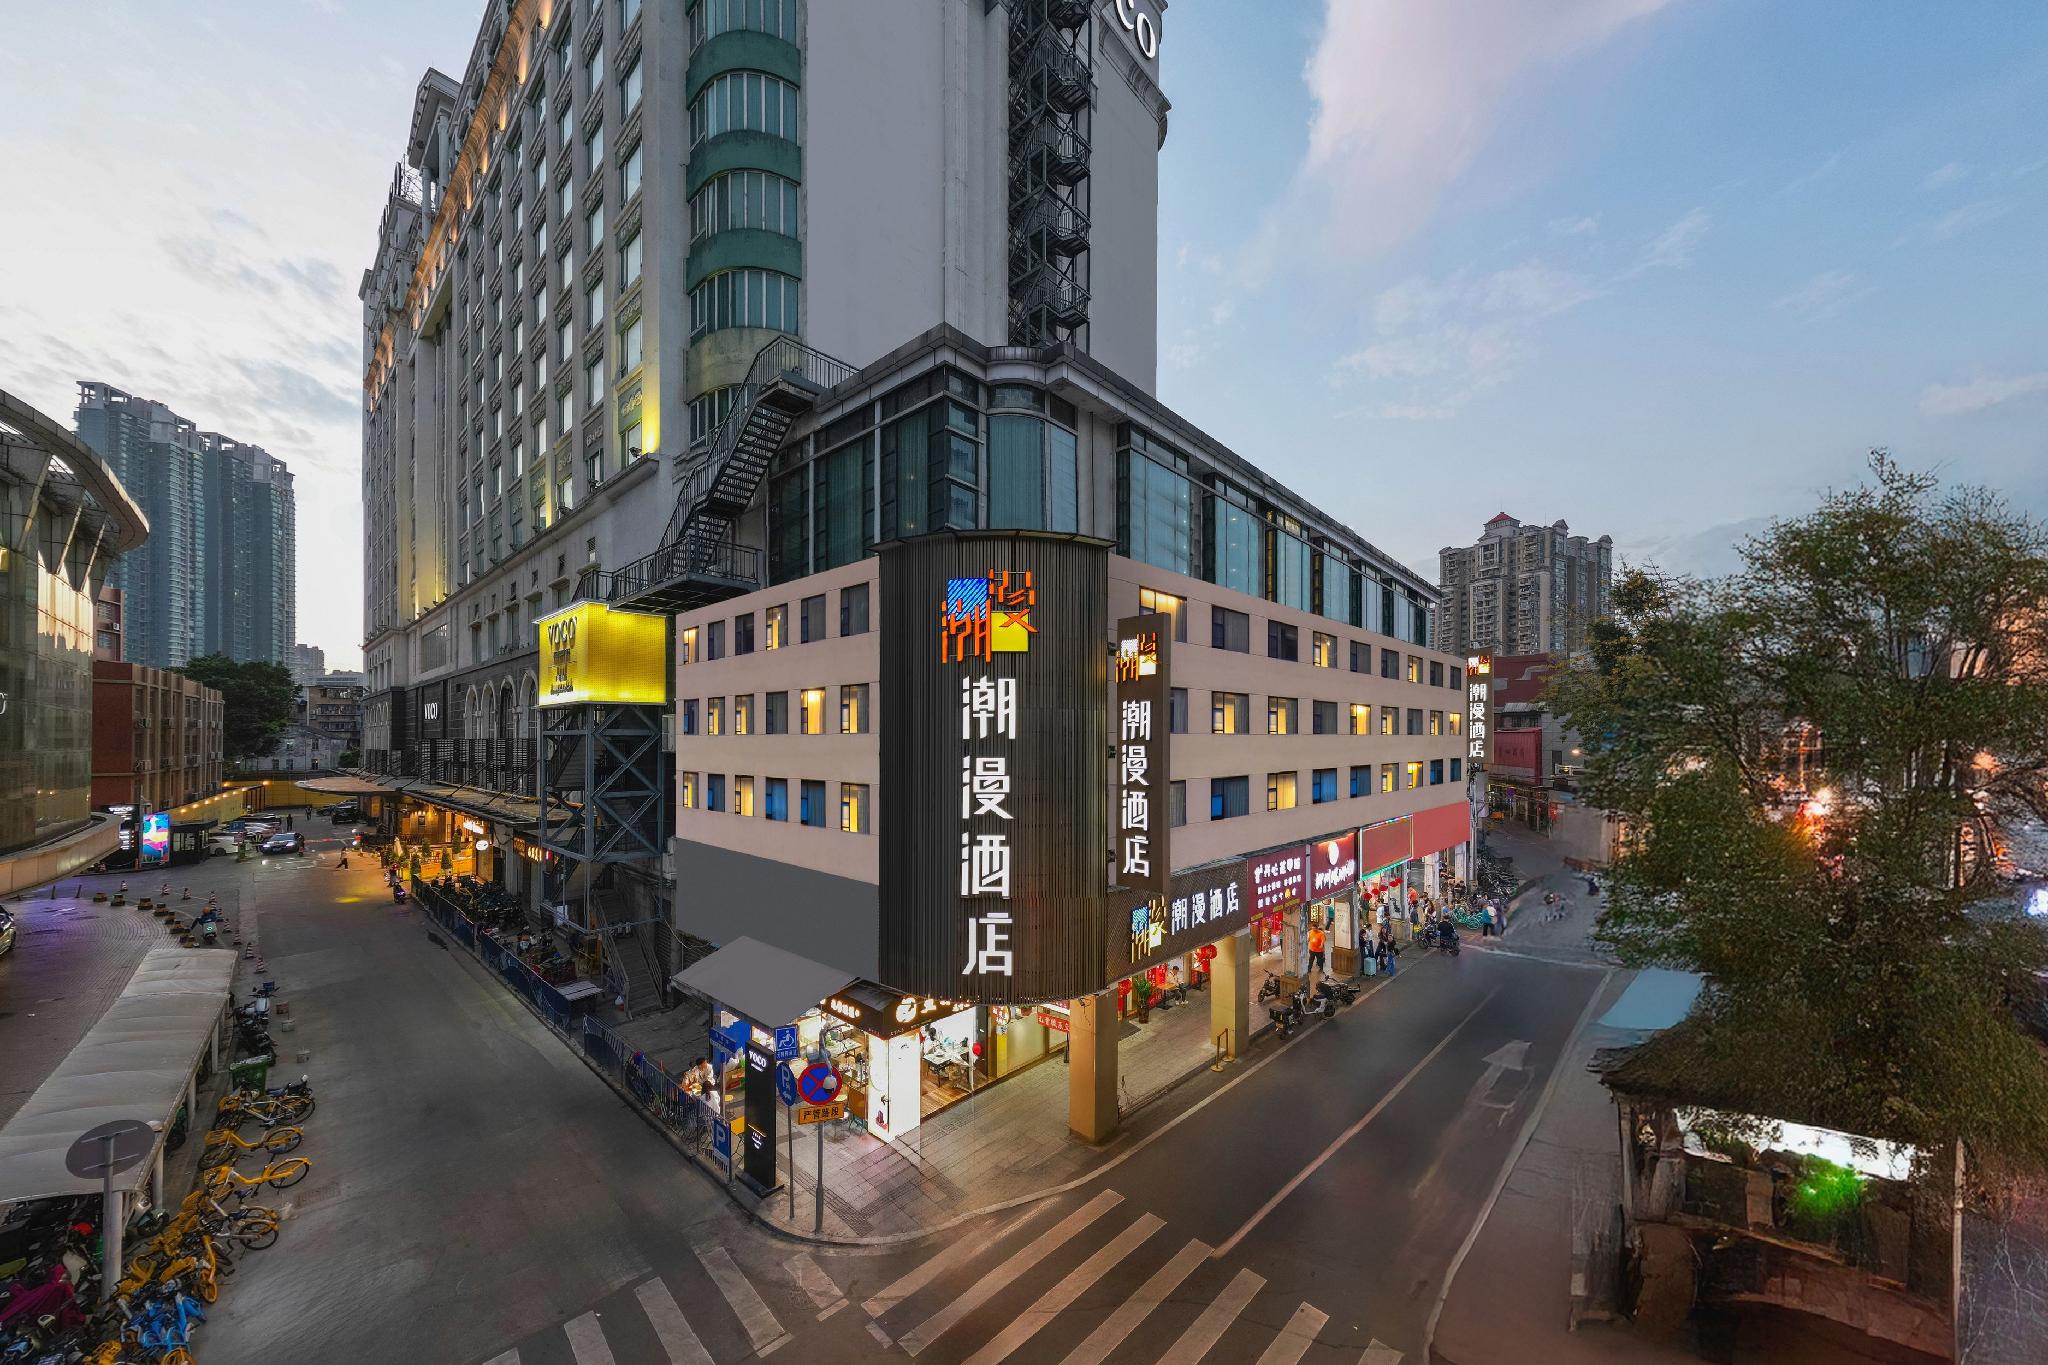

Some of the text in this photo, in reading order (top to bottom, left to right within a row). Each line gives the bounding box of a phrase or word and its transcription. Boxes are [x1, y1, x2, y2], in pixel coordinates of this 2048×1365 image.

[1469, 683, 1487, 758] 潮漫酒店
[1121, 699, 1151, 878] 潮漫酒店
[959, 675, 1018, 977] 潮漫酒店
[1171, 881, 1240, 936] 潮漫酒店
[716, 1124, 726, 1147] P
[803, 1106, 839, 1121] 严管路段
